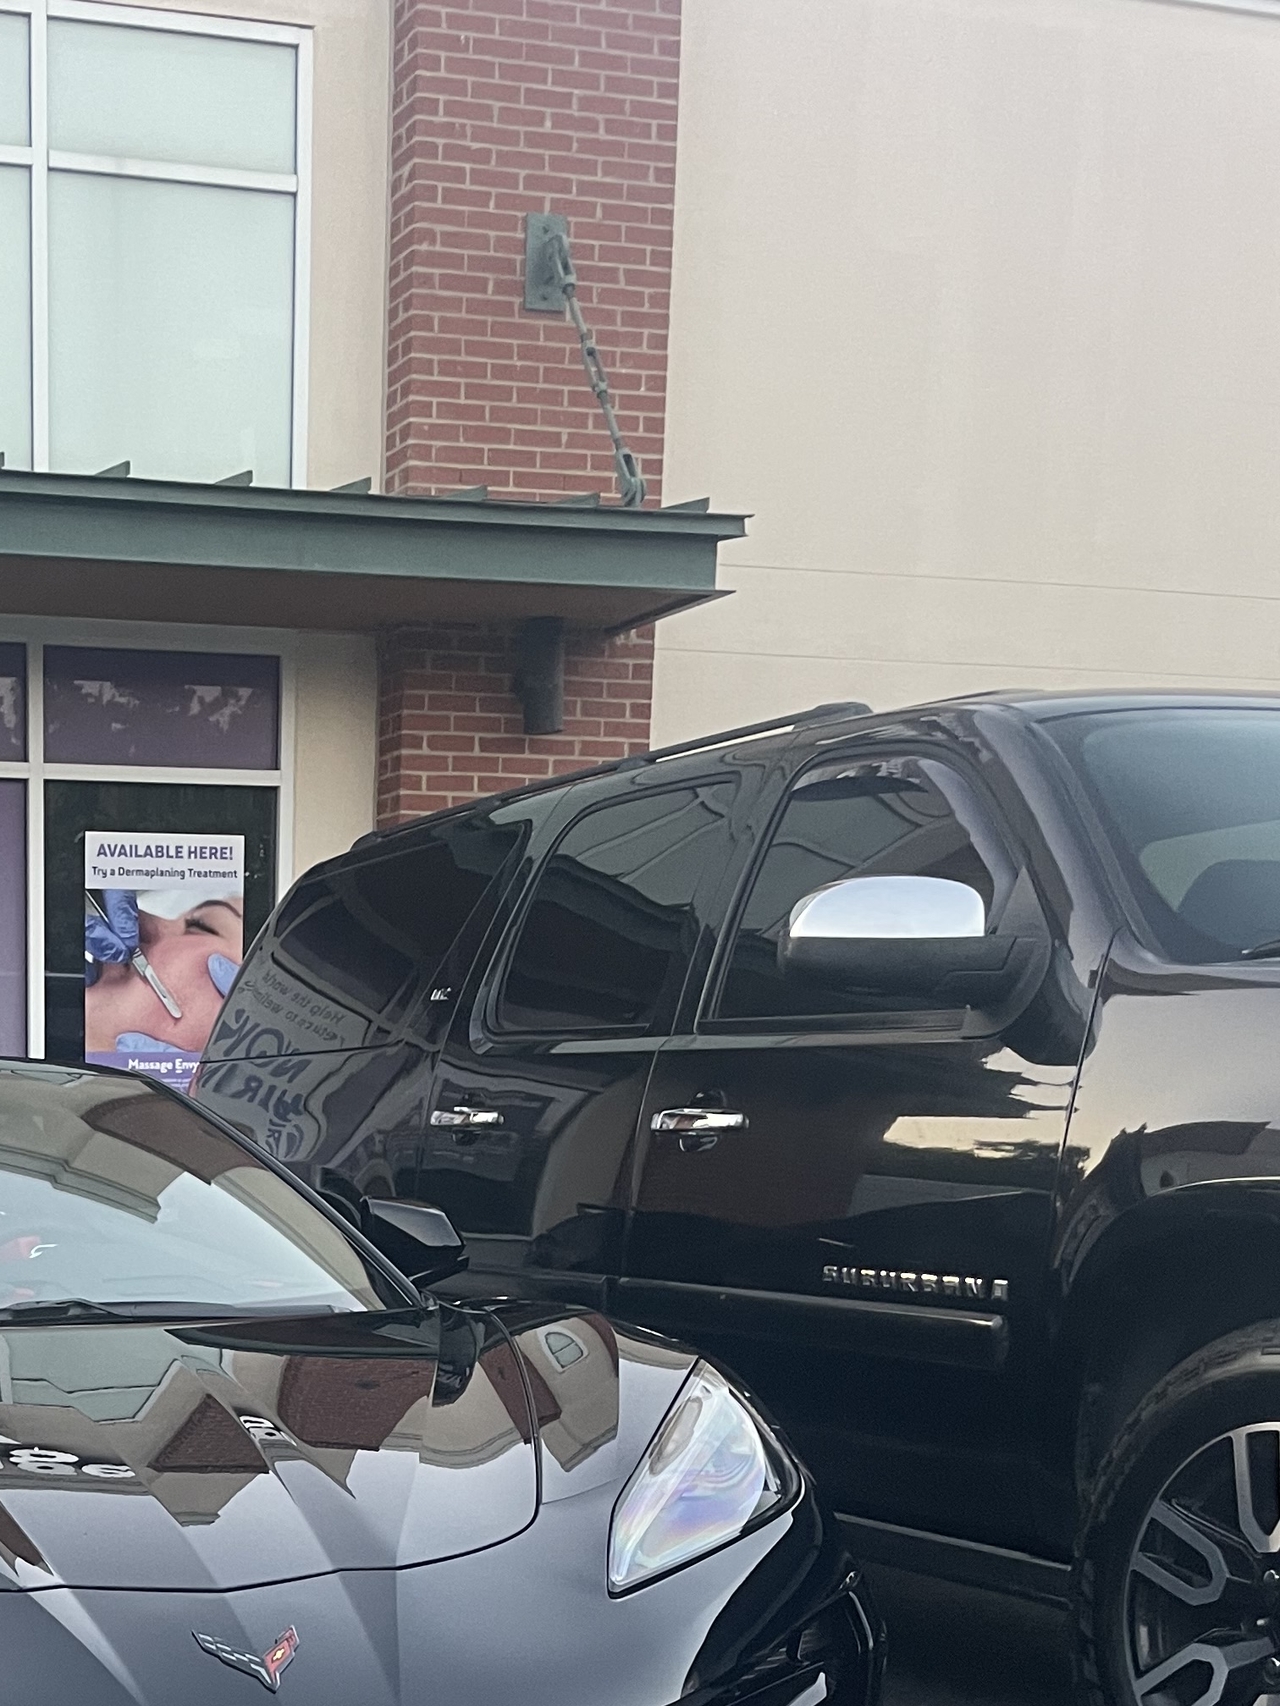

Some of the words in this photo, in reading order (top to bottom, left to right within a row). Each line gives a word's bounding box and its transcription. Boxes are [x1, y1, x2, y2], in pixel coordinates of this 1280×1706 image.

[96, 843, 184, 859] AVAILABLE
[187, 844, 234, 860] HERE!
[91, 866, 107, 880] Try
[109, 870, 116, 878] a
[117, 866, 186, 881] Dermaplaning
[187, 867, 238, 879] Treatment
[128, 1058, 173, 1073] Massage
[174, 1058, 200, 1074] Envy
